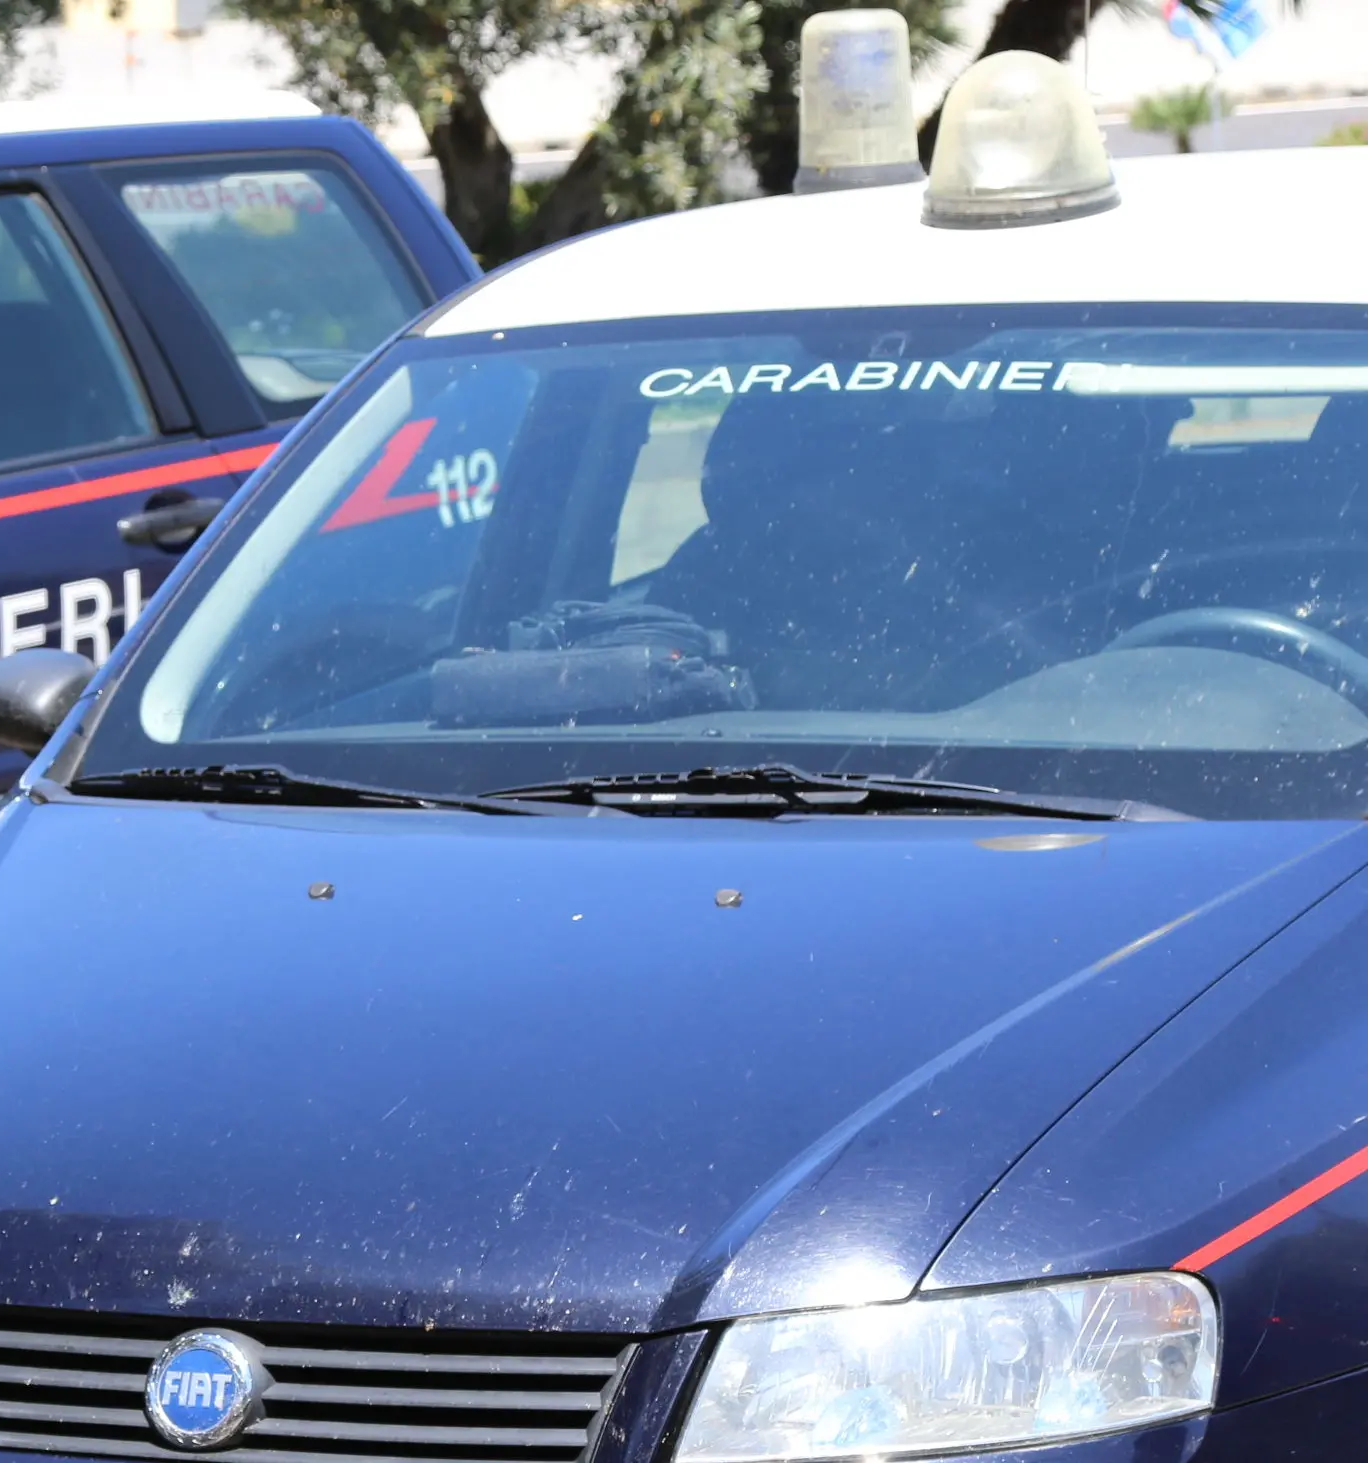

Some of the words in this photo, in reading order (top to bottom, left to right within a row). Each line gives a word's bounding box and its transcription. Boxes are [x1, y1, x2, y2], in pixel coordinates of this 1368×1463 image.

[639, 361, 1133, 398] CARABINIERI
[427, 447, 498, 528] 112
[161, 1370, 233, 1411] FIAT
